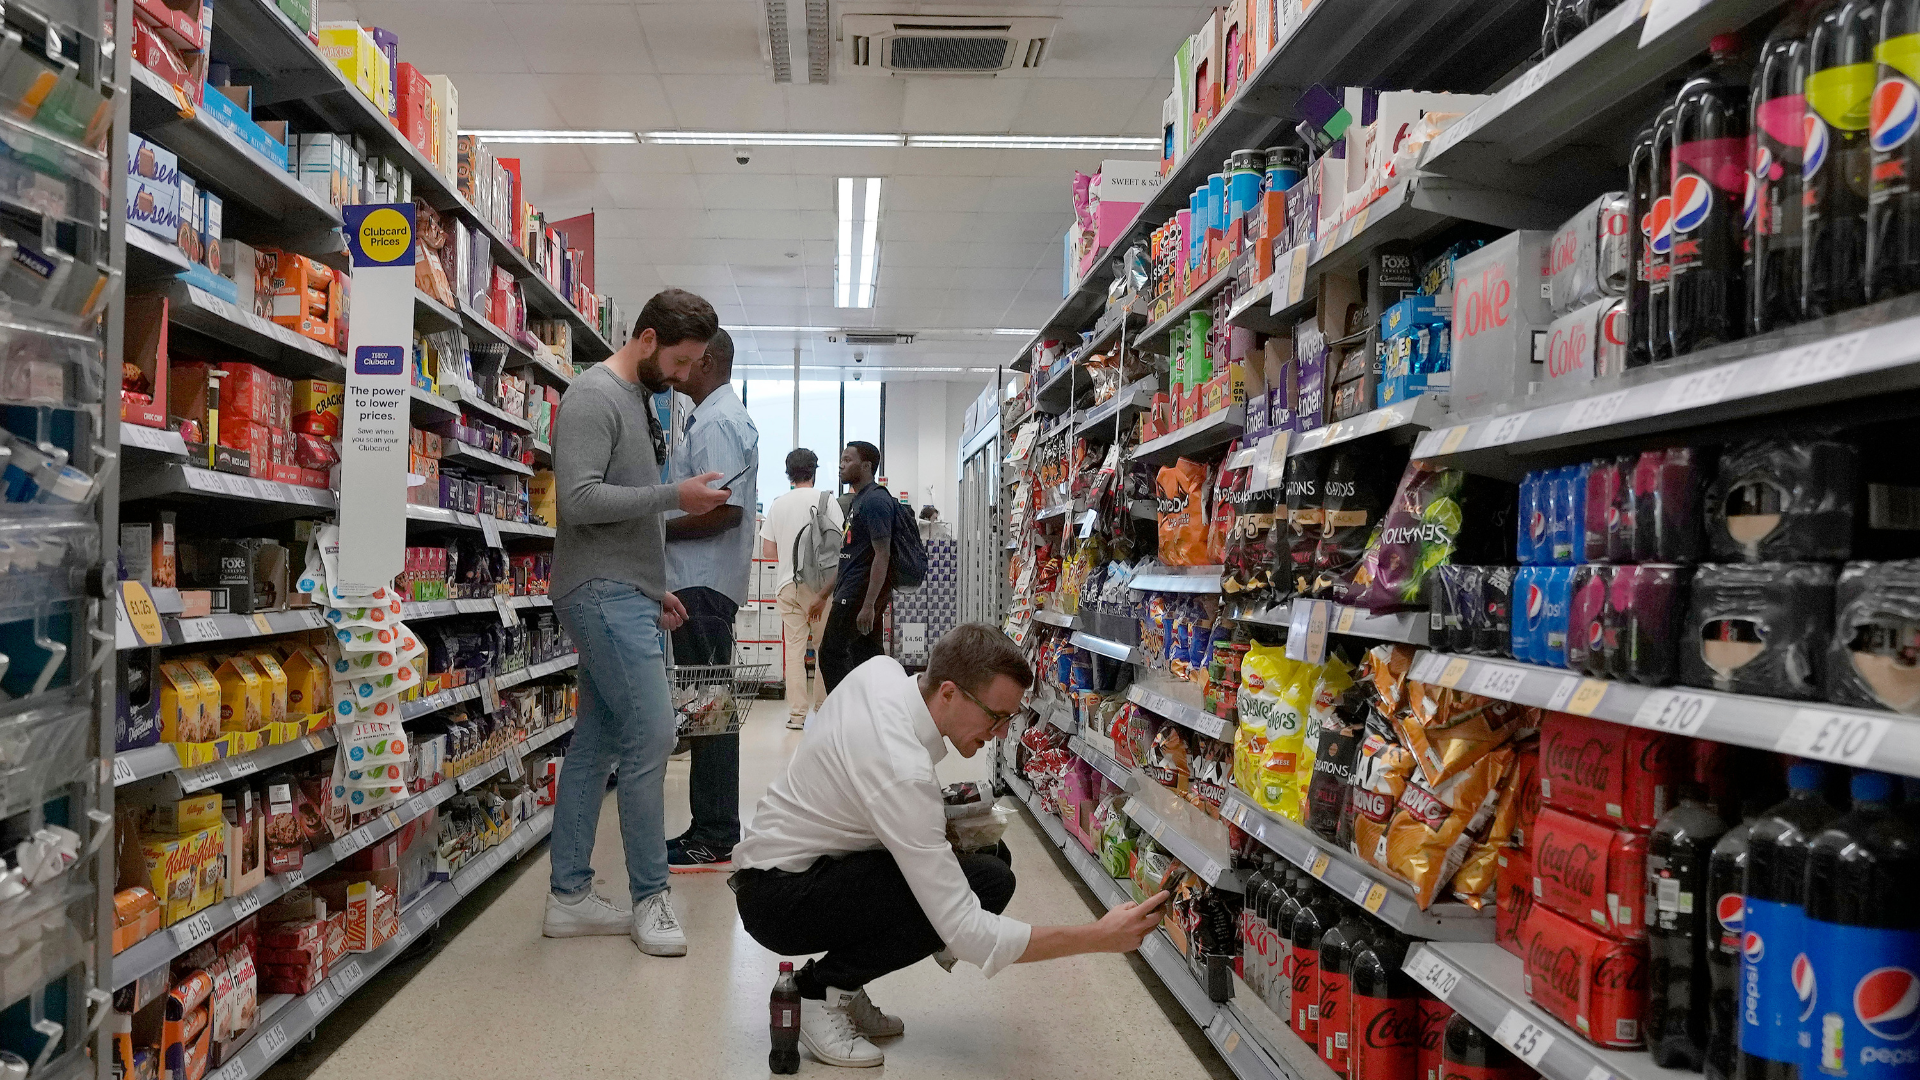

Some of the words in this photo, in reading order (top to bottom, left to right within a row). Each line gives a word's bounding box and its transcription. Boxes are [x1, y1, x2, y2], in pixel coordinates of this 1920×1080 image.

[320, 46, 353, 57] MAKERS
[1111, 178, 1139, 186] SWEET
[363, 226, 407, 237] Clubcard
[370, 237, 400, 246] Prices
[1551, 232, 1577, 276] Coke
[1452, 270, 1511, 342] Coke
[1549, 326, 1587, 379] Coke
[363, 358, 395, 366] Clubcard
[350, 386, 369, 395] The
[372, 387, 405, 398] power
[355, 399, 366, 408] to
[369, 399, 399, 408] lower
[359, 411, 396, 421] prices.
[357, 427, 374, 435] Save
[1286, 481, 1316, 497] ATIONS
[129, 599, 152, 616] £1.25
[195, 621, 220, 639] £1.15
[1655, 695, 1703, 731] £10
[1267, 711, 1297, 736] avers
[1807, 716, 1876, 759] £10
[188, 916, 212, 942] £1.15
[1425, 963, 1457, 994] £4.70
[1745, 963, 1761, 1027] pepsi
[1512, 1023, 1544, 1057] £5
